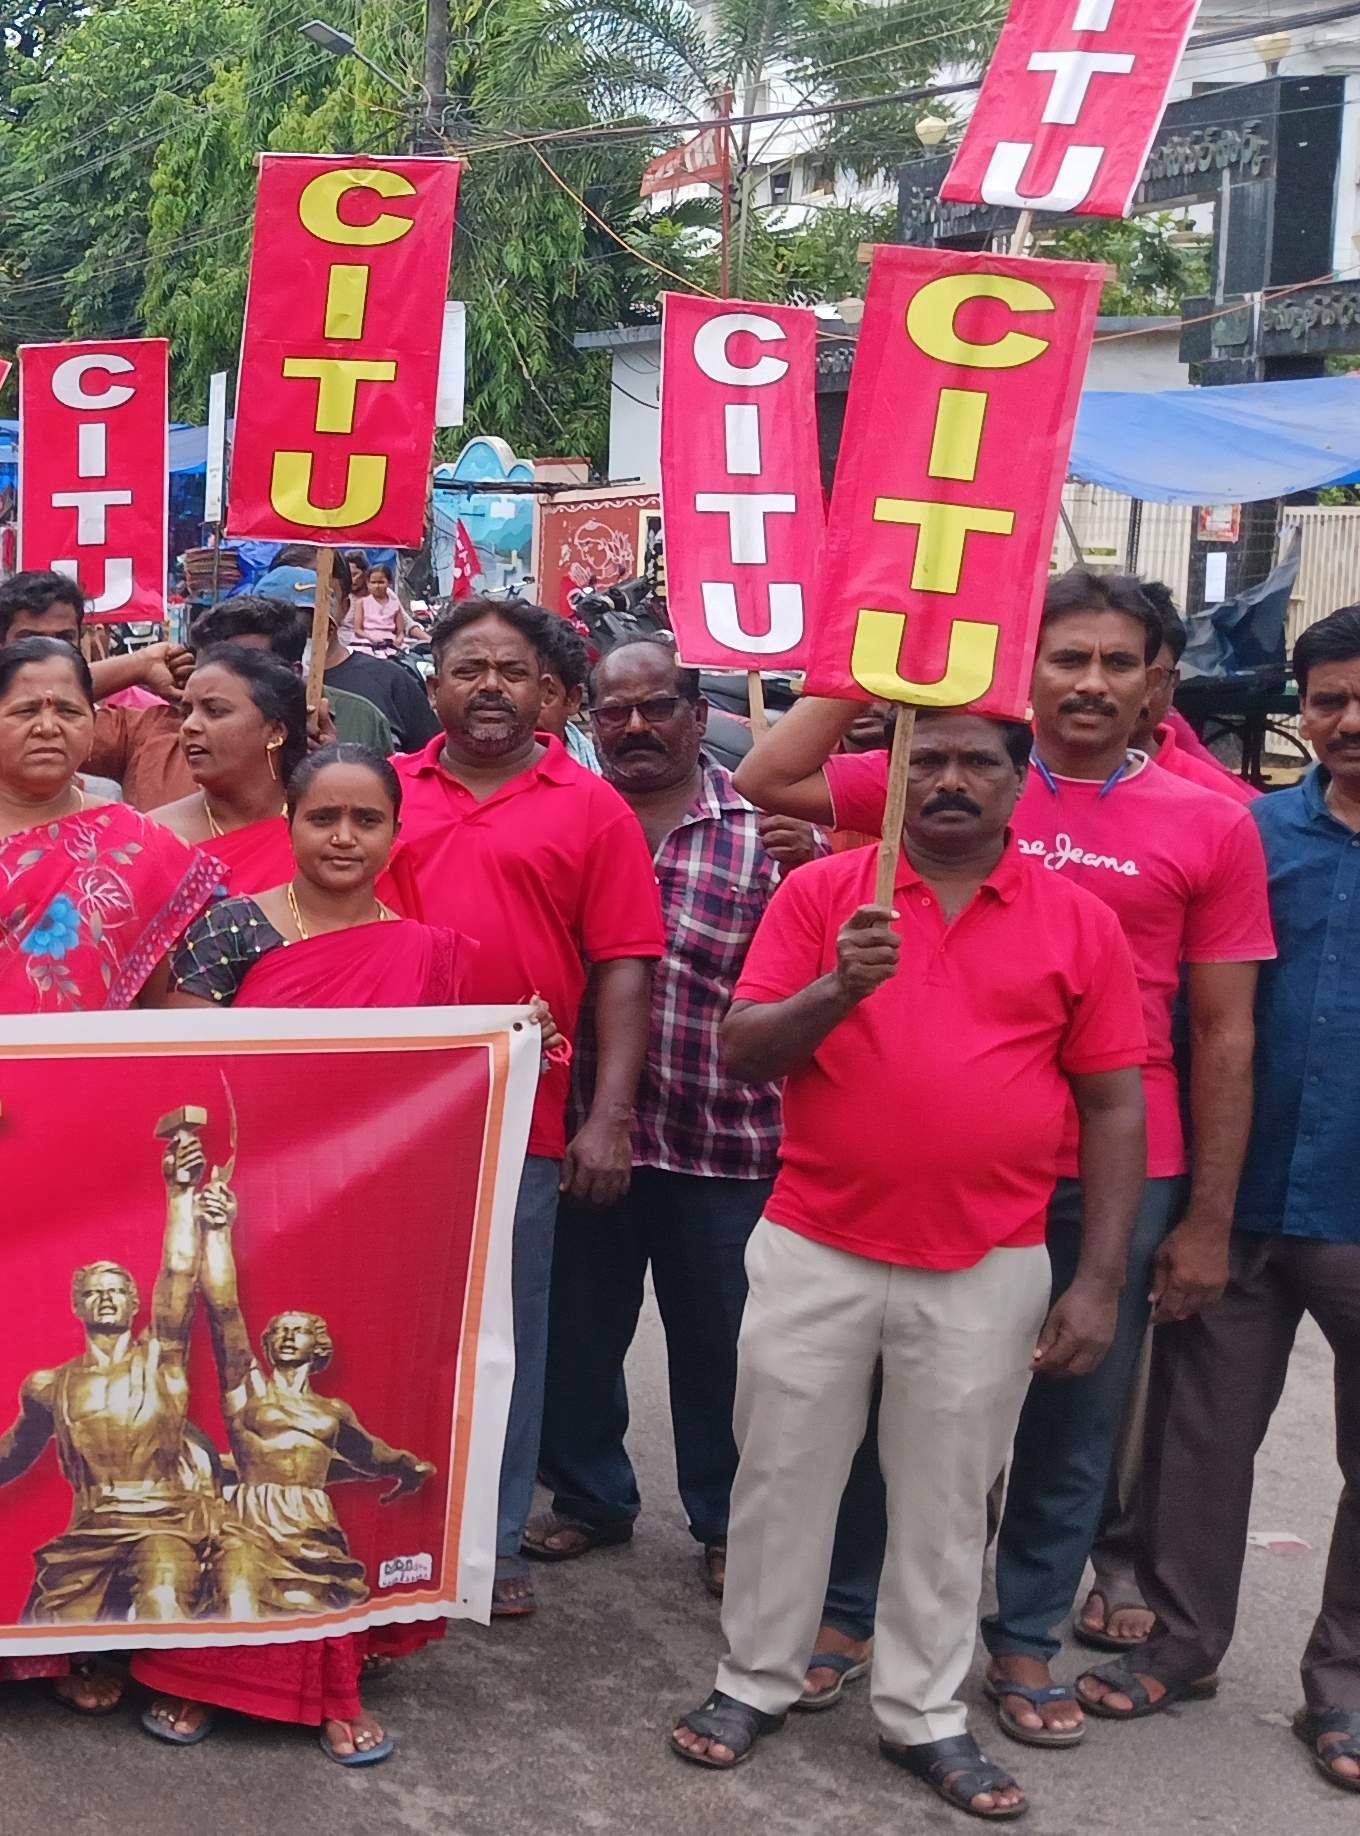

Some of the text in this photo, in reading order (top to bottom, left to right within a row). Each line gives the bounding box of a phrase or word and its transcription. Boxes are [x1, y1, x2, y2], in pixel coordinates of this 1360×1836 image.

[51, 354, 137, 614] CITU
[269, 168, 418, 528] CITU
[693, 312, 803, 654] CITU
[850, 272, 1055, 709] CITU
[1044, 833, 1140, 876] Jeans
